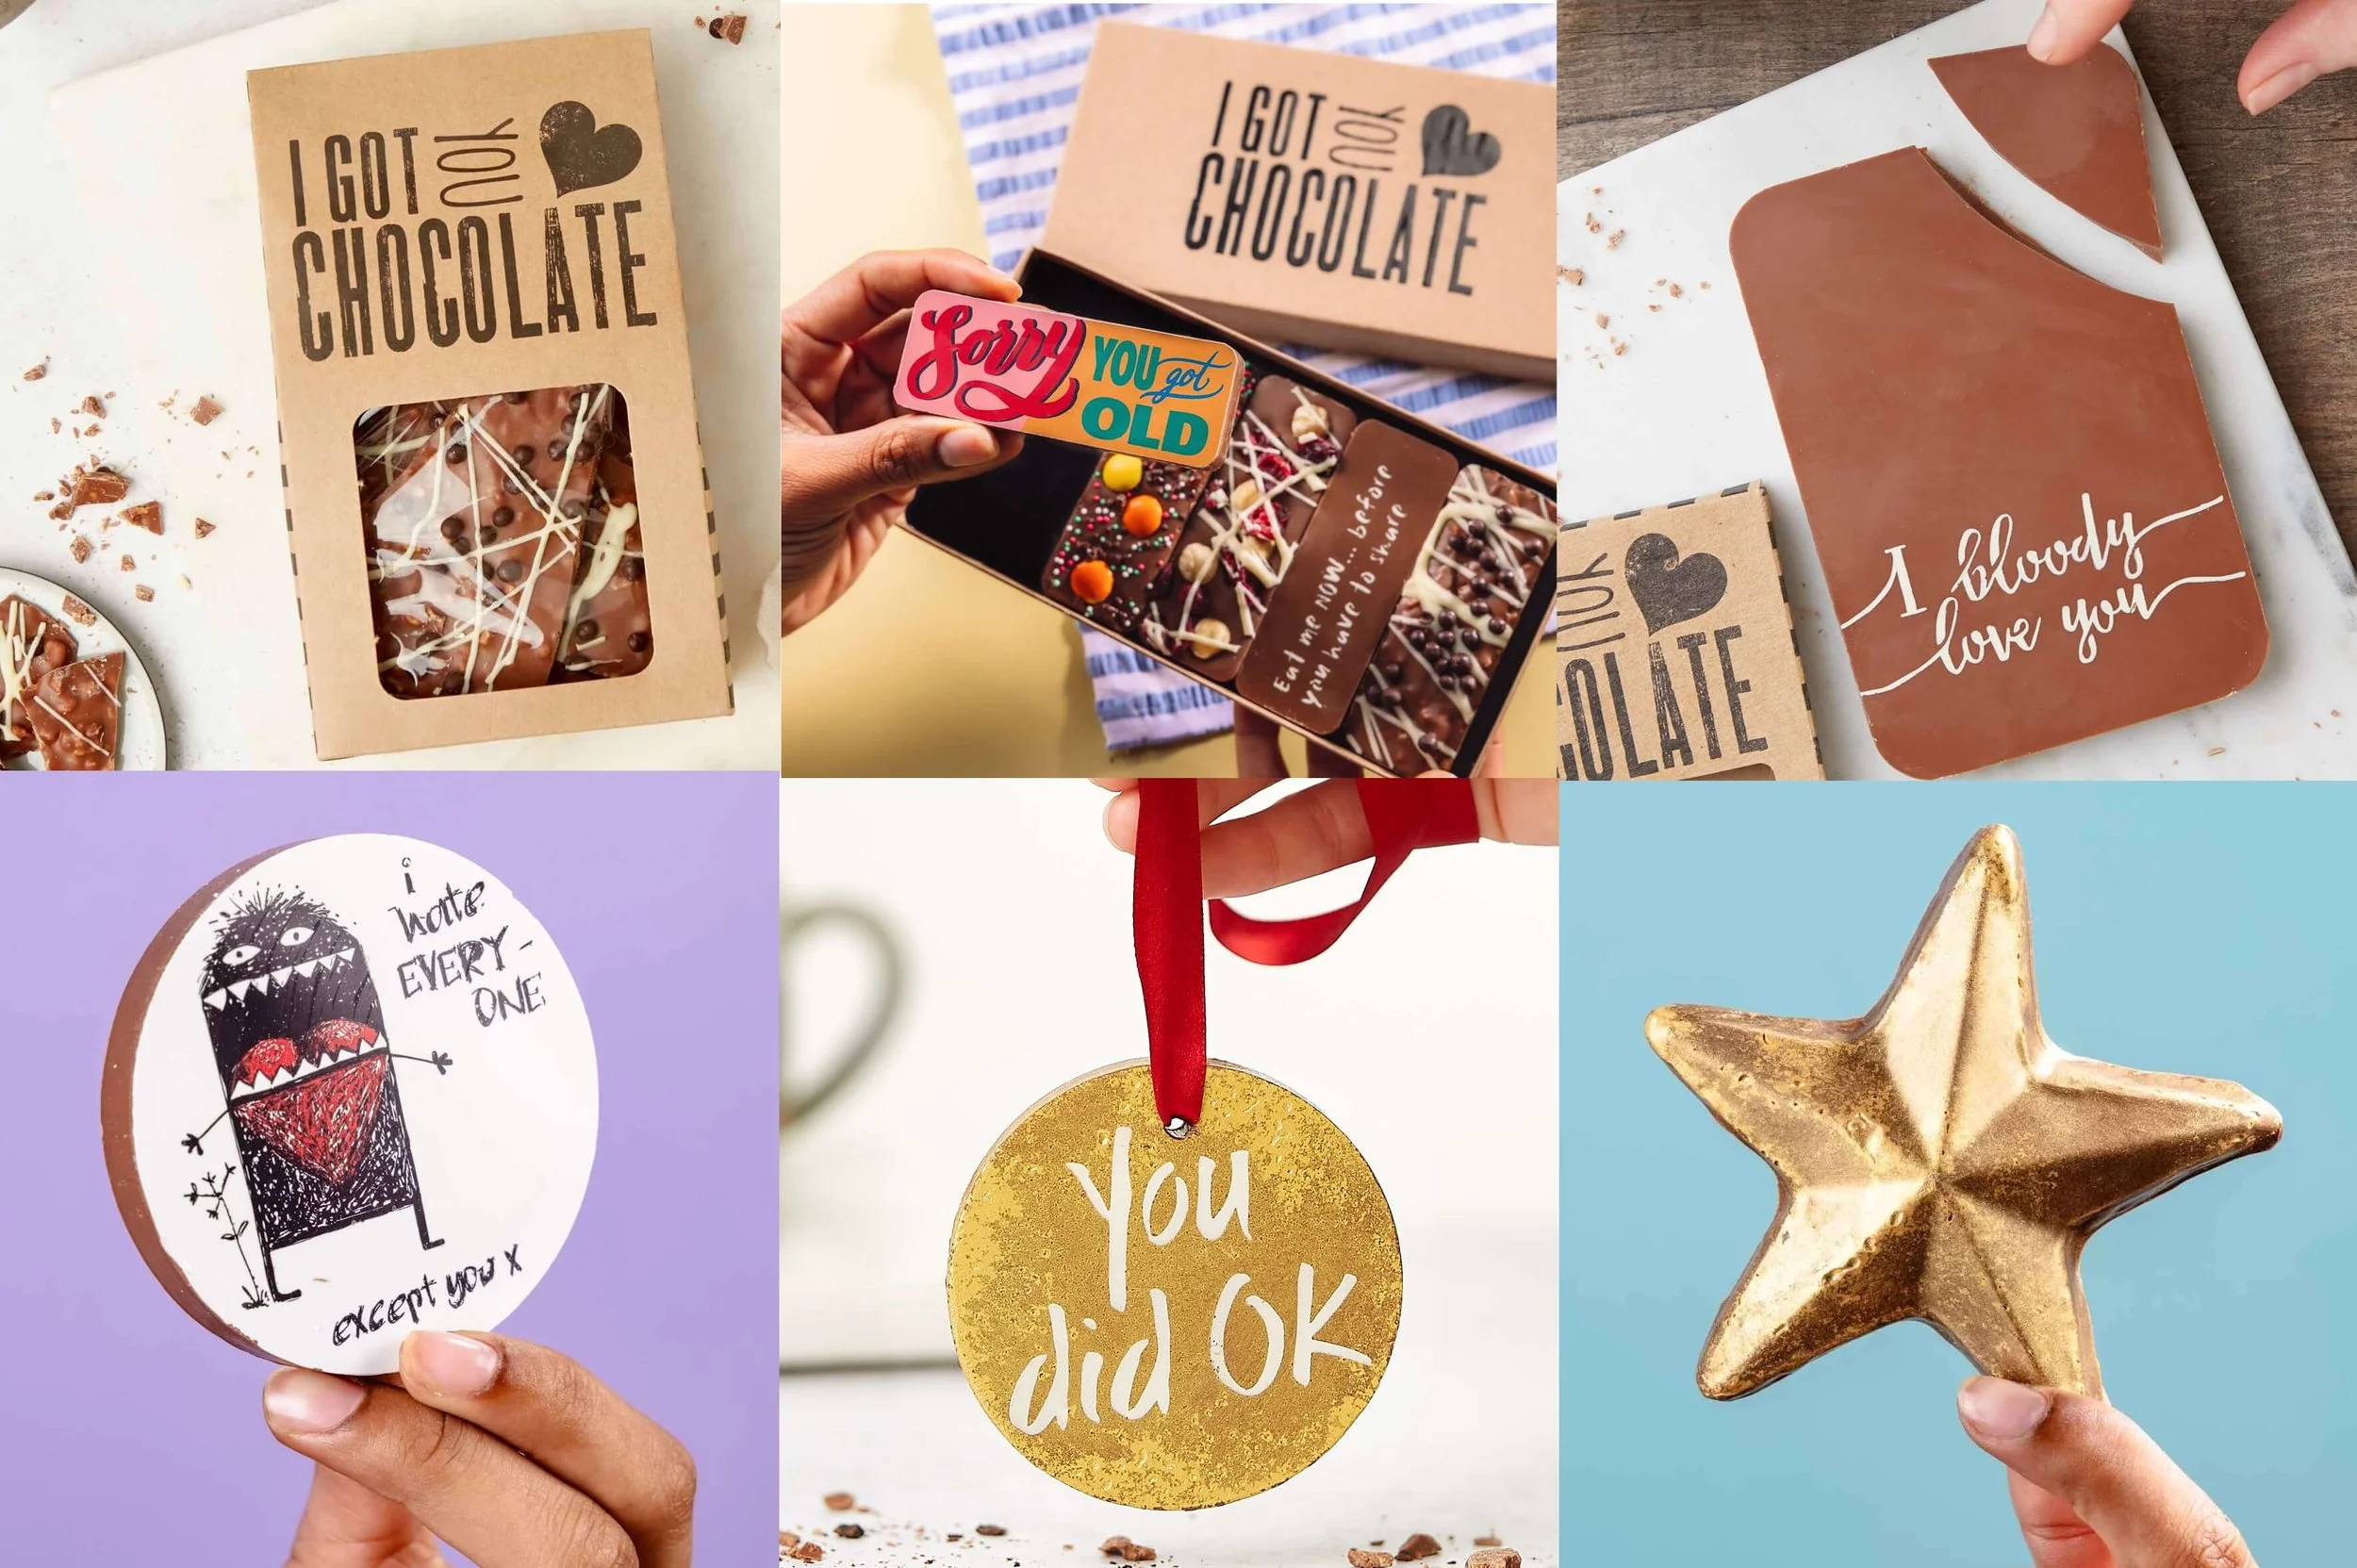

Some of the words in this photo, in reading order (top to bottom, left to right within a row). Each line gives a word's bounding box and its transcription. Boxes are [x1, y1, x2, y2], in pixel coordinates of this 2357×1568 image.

[289, 140, 307, 226] I
[324, 127, 419, 222] GOT
[434, 117, 524, 207] YOU
[1211, 80, 1232, 147] I
[1241, 85, 1327, 160] GOT
[1328, 105, 1407, 173] YOU
[291, 199, 658, 362] CHOCOLATE
[1184, 152, 1488, 296] CHOCOLATE
[907, 305, 1087, 421] Sorry
[1093, 336, 1162, 390] YOU
[1140, 351, 1232, 404] got
[1081, 396, 1209, 455] OLD
[1273, 649, 1306, 694] Eat
[1298, 615, 1321, 647] me
[1346, 464, 1393, 539] before
[1951, 492, 2224, 602] bloody
[1301, 663, 1331, 708] you
[1321, 602, 1360, 660] have
[1349, 571, 1376, 595] to
[1370, 503, 1408, 565] share
[1860, 596, 2041, 697] love
[2062, 571, 2246, 664] you
[402, 857, 416, 895] i
[471, 971, 546, 1027] ONE
[1065, 1127, 1253, 1312] You
[332, 1274, 437, 1346] except
[446, 1256, 495, 1309] you
[1009, 1288, 1170, 1435] did
[1210, 1263, 1372, 1396] OK
